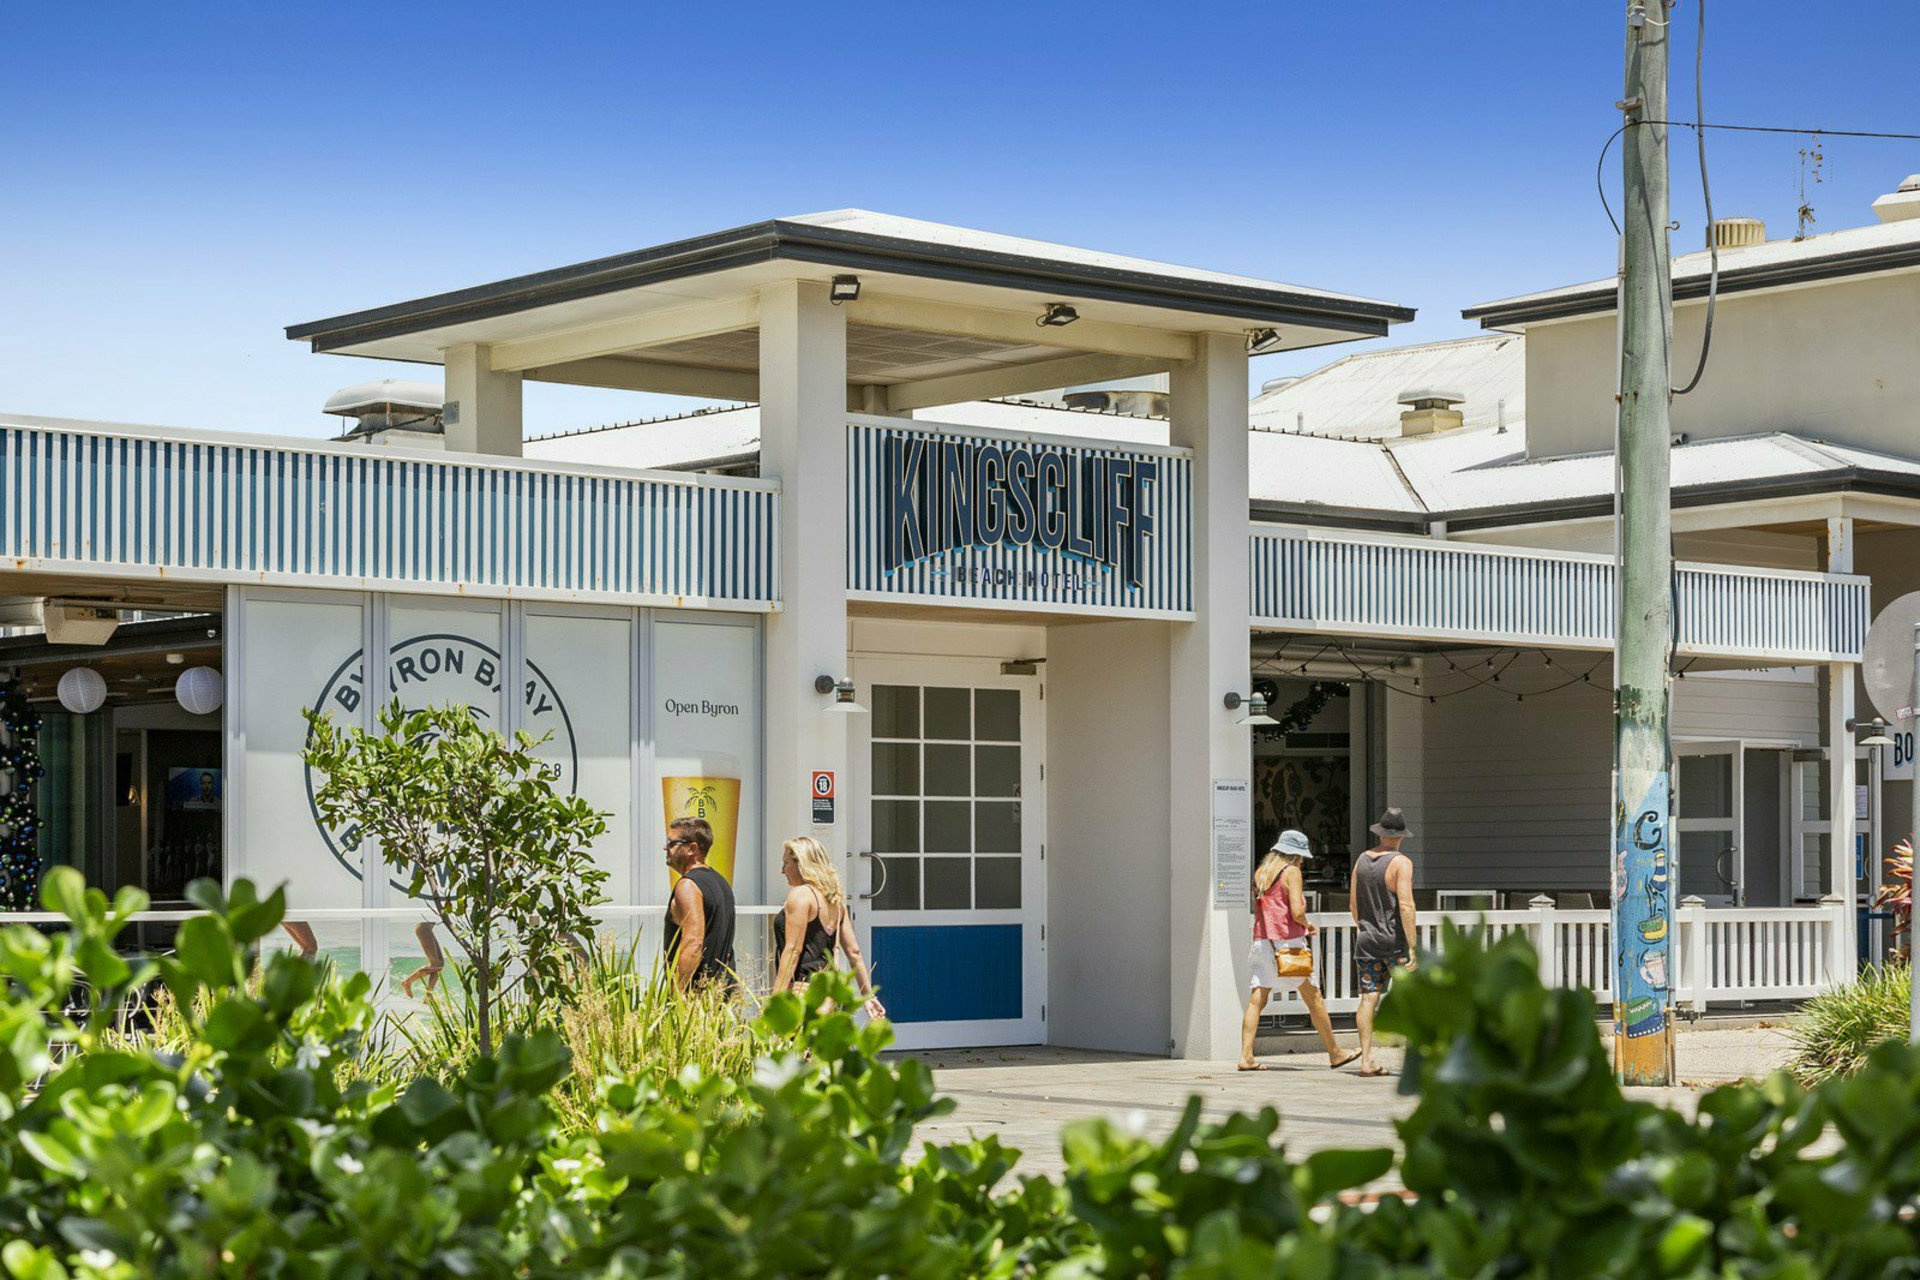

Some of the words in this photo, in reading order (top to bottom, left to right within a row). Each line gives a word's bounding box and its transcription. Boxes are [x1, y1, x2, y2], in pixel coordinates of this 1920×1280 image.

[887, 435, 1157, 588] KINGSCLIFF
[957, 566, 1018, 586] BEACH
[1027, 571, 1083, 591] HOTEL
[665, 699, 699, 716] Open
[701, 700, 739, 717] Byron
[818, 781, 828, 792] 18
